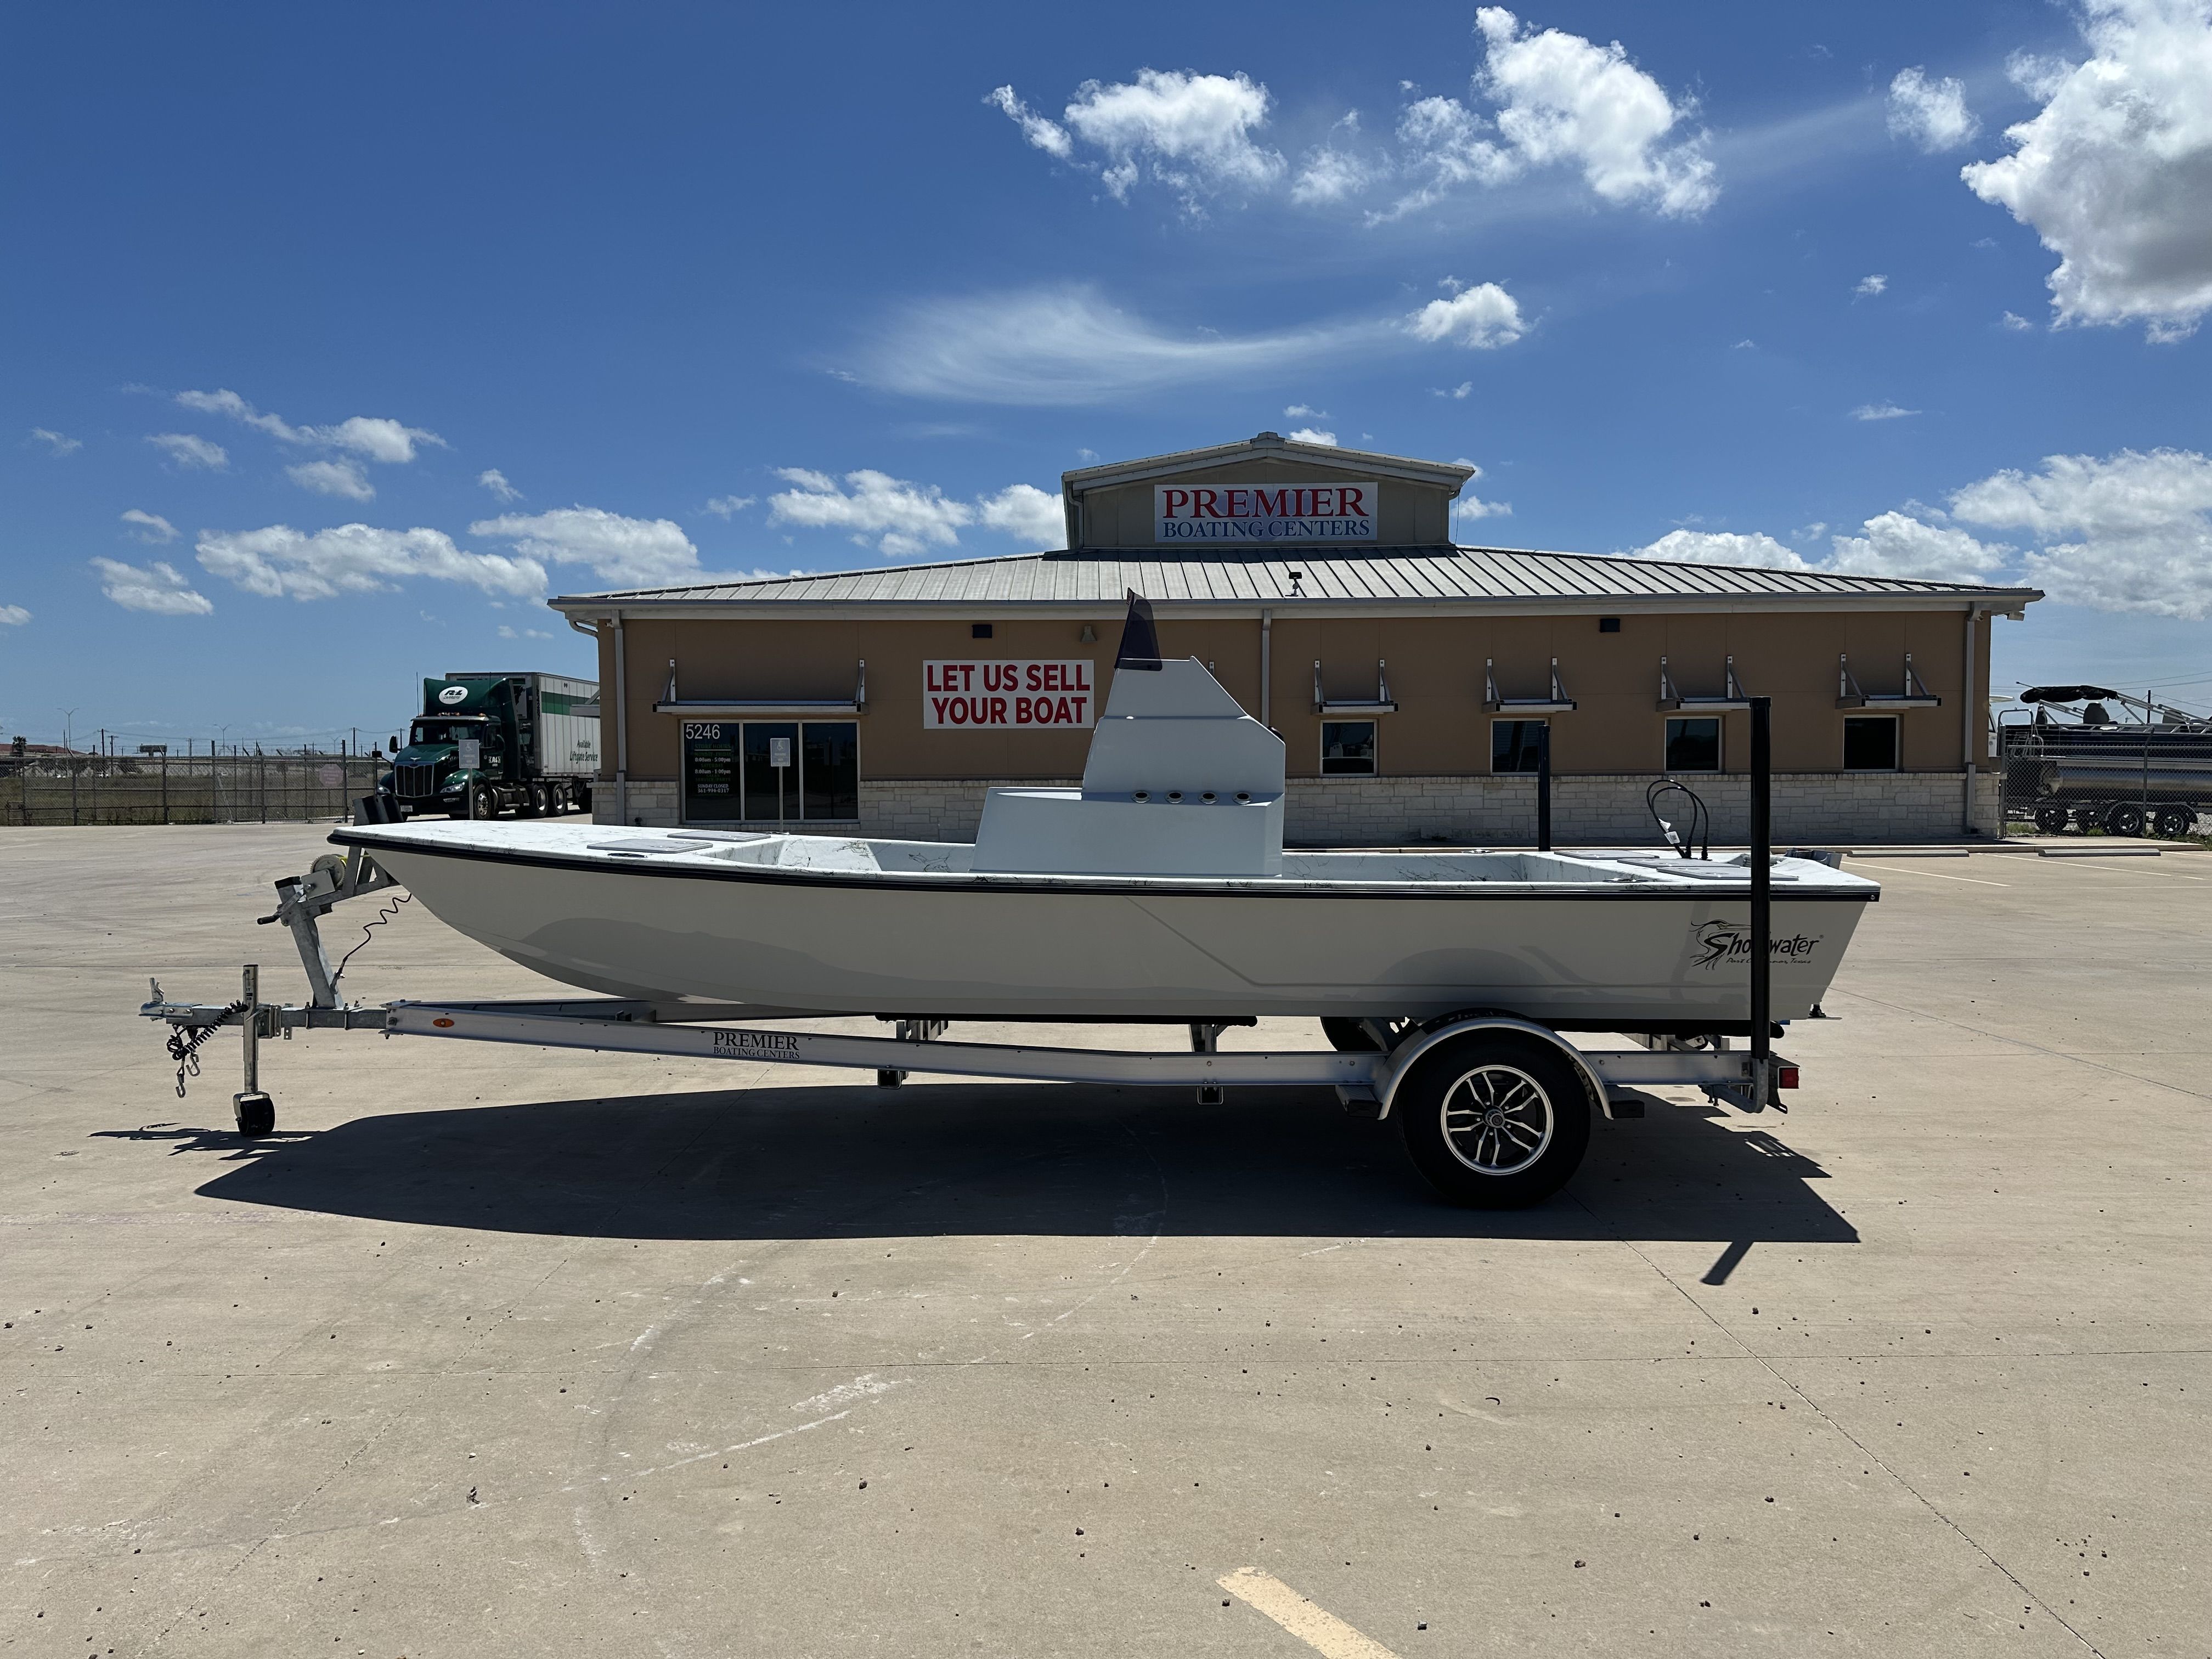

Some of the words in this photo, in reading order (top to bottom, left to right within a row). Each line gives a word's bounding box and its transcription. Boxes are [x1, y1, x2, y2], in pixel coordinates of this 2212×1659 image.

[1163, 488, 1369, 518] PREMIER
[1163, 521, 1263, 538] BOATING
[1268, 520, 1370, 537] CENTERS
[927, 665, 975, 692] LET
[983, 664, 1019, 692] US
[1026, 664, 1090, 691] SELL
[932, 697, 1008, 724] YOUR
[1015, 697, 1087, 724] BOAT
[685, 724, 720, 740] 5246
[577, 740, 591, 748] Available
[569, 751, 584, 764] Liftgate
[585, 752, 598, 761] Service
[1692, 932, 1820, 967] Showater
[713, 1031, 799, 1051] PREMIER
[713, 1046, 755, 1057] BOATING
[757, 1049, 800, 1059] CENTERS
